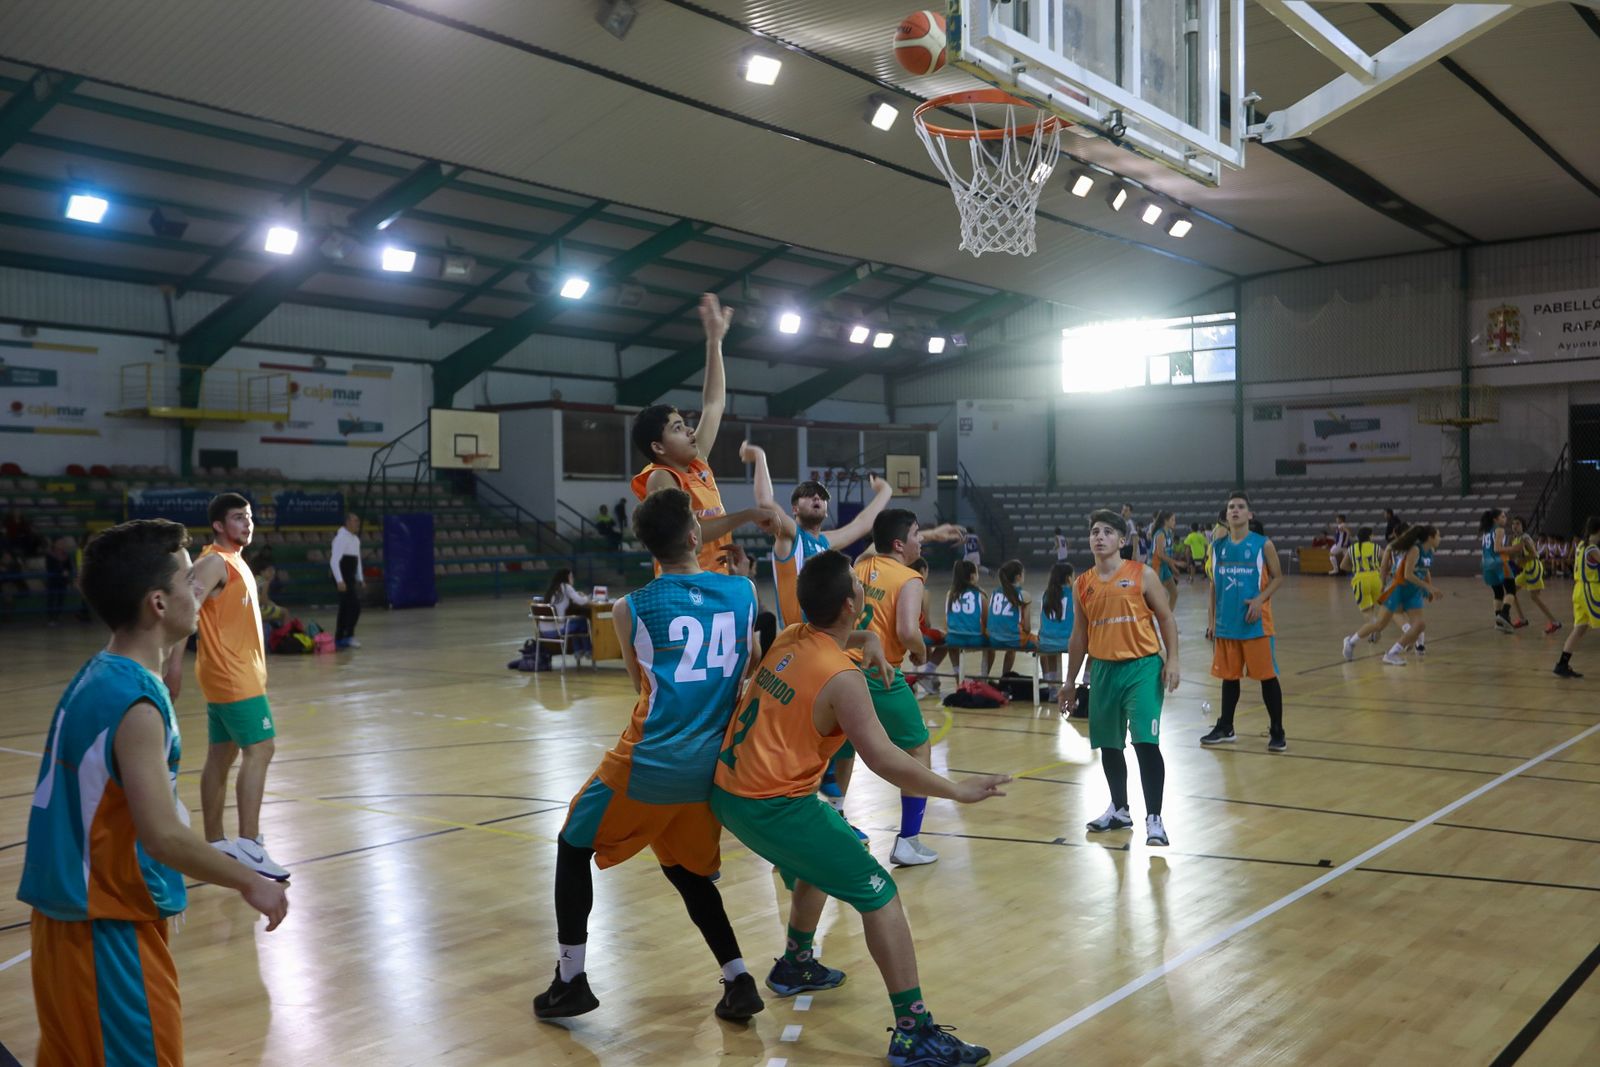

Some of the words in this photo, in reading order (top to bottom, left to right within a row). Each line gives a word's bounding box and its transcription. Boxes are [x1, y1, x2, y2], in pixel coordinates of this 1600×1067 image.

[302, 383, 362, 402] cajamar
[26, 402, 87, 418] cajamar
[1226, 566, 1254, 575] cajamar
[992, 592, 1014, 616] 82
[668, 611, 739, 683] 24
